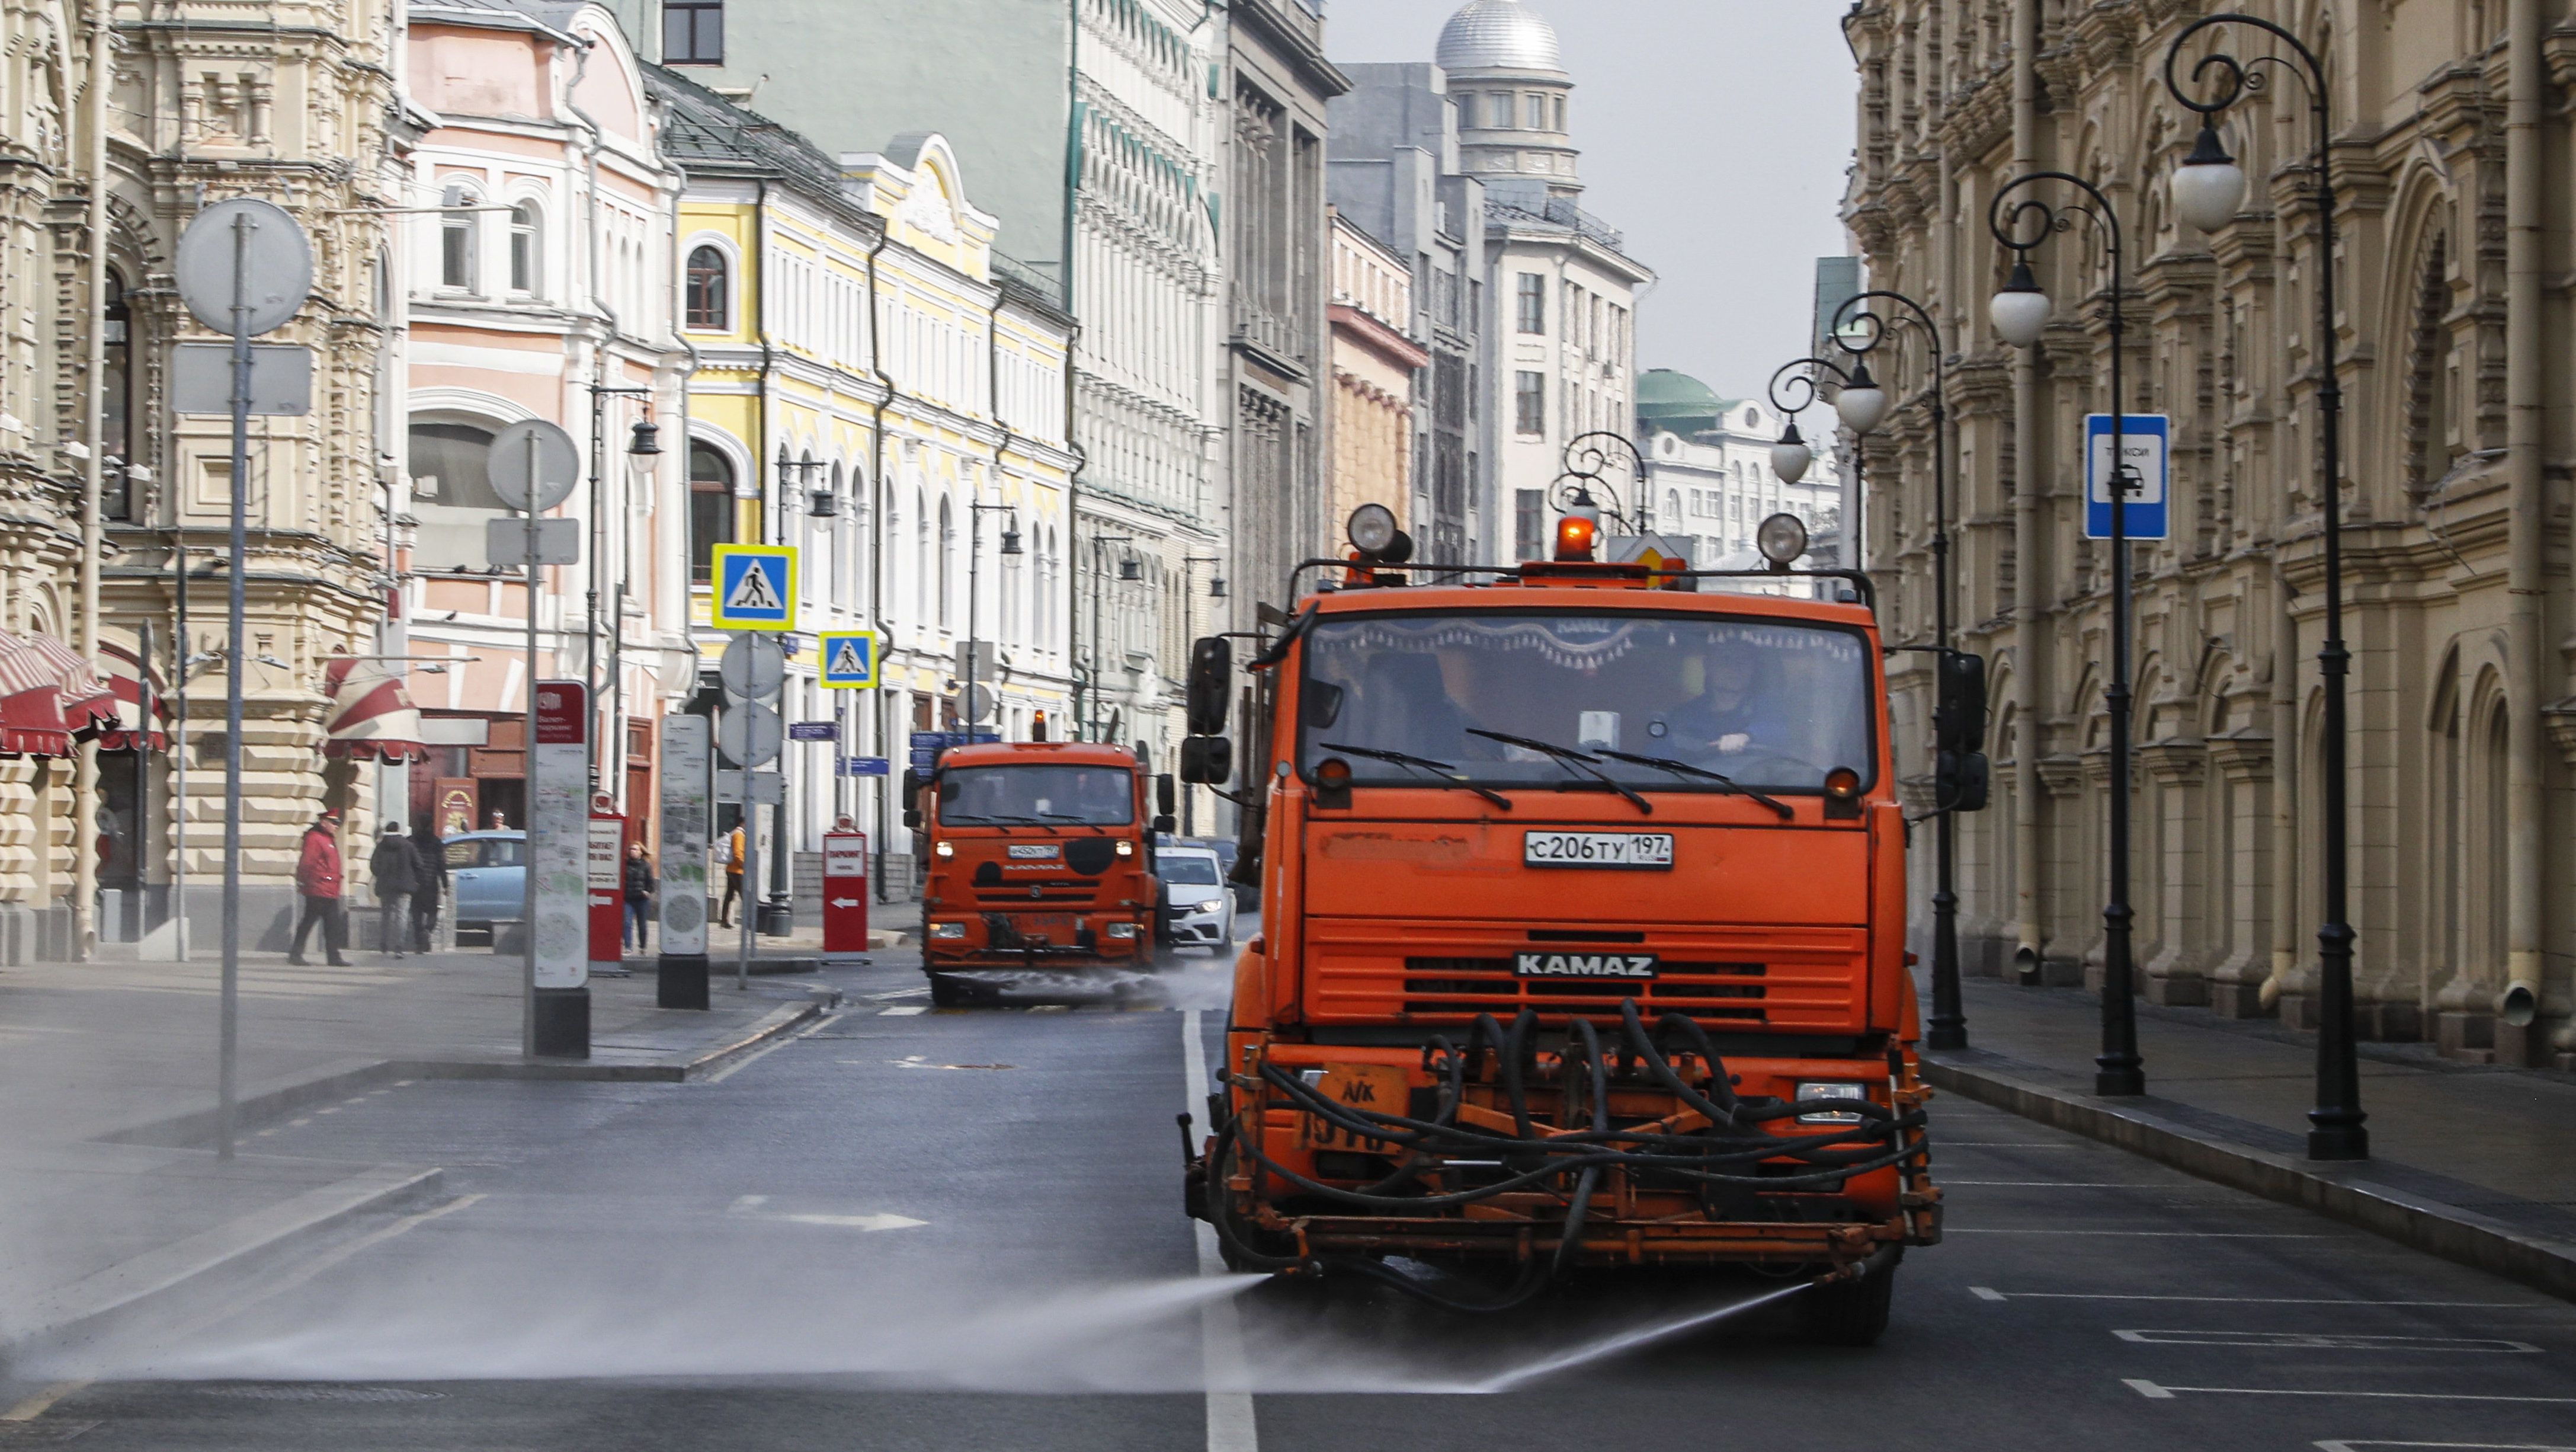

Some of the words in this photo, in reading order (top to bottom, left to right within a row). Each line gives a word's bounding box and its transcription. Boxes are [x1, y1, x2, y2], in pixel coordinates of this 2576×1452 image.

[2104, 447, 2149, 457] ТКСИ
[1533, 836, 1626, 860] С206ТУ
[1631, 836, 1665, 855] 197
[1518, 955, 1653, 977] KAMAZ
